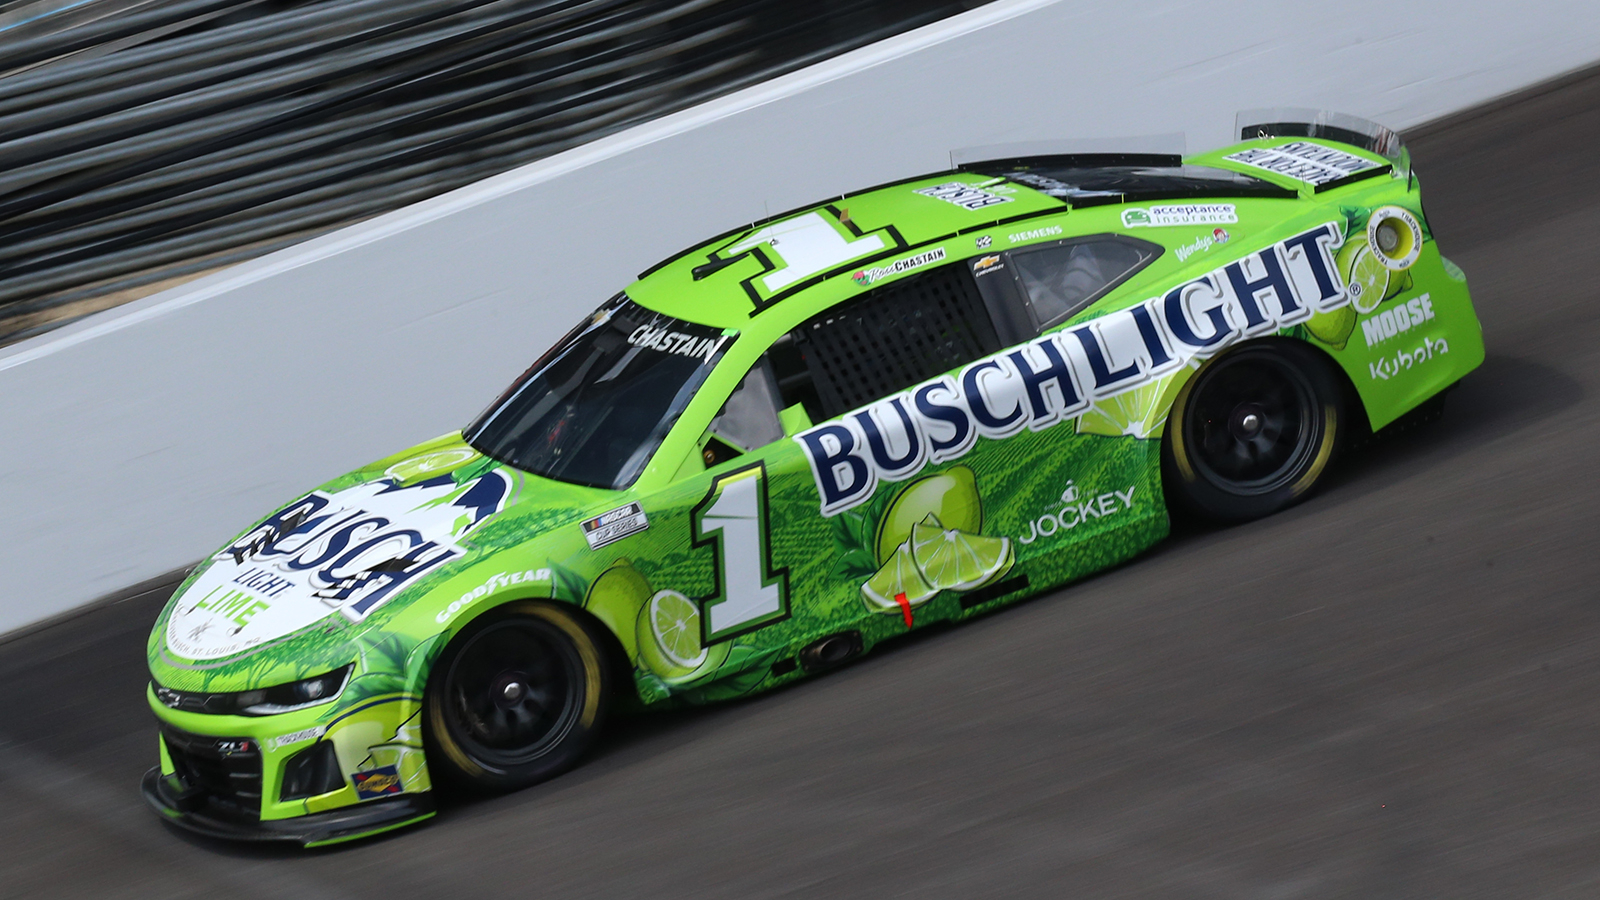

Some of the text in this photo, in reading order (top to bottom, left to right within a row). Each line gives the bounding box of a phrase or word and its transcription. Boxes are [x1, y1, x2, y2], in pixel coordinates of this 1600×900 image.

[1153, 205, 1232, 215] acceptance
[1156, 214, 1236, 224] insurance
[716, 207, 897, 302] 1
[1008, 225, 1063, 243] SIEMENS
[1174, 235, 1213, 262] Wendy's
[894, 249, 945, 272] CHASTAIN
[627, 324, 717, 359] CHASTAIN
[1361, 292, 1435, 349] MOOSE
[1369, 336, 1449, 380] Kubota
[1019, 485, 1135, 545] JOCKEY
[217, 490, 463, 620] BUSCH
[696, 467, 787, 643] 1
[232, 567, 296, 598] LIGHT
[435, 568, 552, 625] GOODYEAR
[195, 585, 273, 628] LIME
